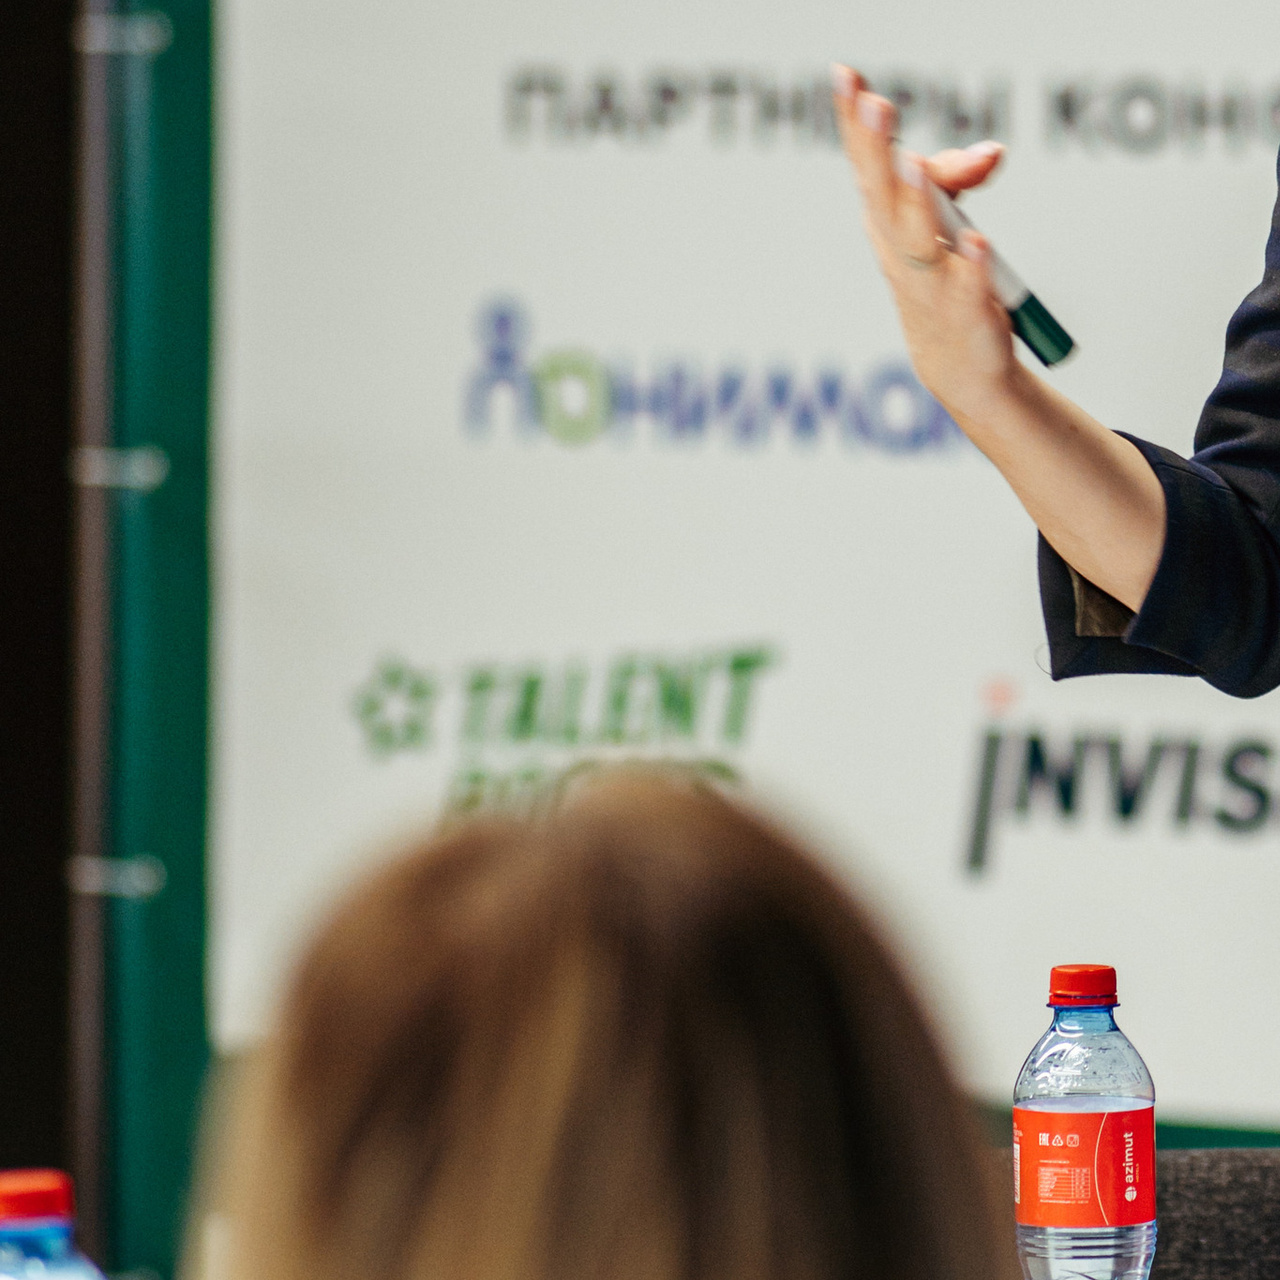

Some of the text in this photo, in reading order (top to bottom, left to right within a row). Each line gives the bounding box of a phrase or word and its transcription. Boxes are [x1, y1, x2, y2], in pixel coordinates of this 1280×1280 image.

[502, 63, 1010, 147] ПАРТНРЫ
[459, 642, 778, 746] TALENT
[1123, 1132, 1134, 1183] azimut
